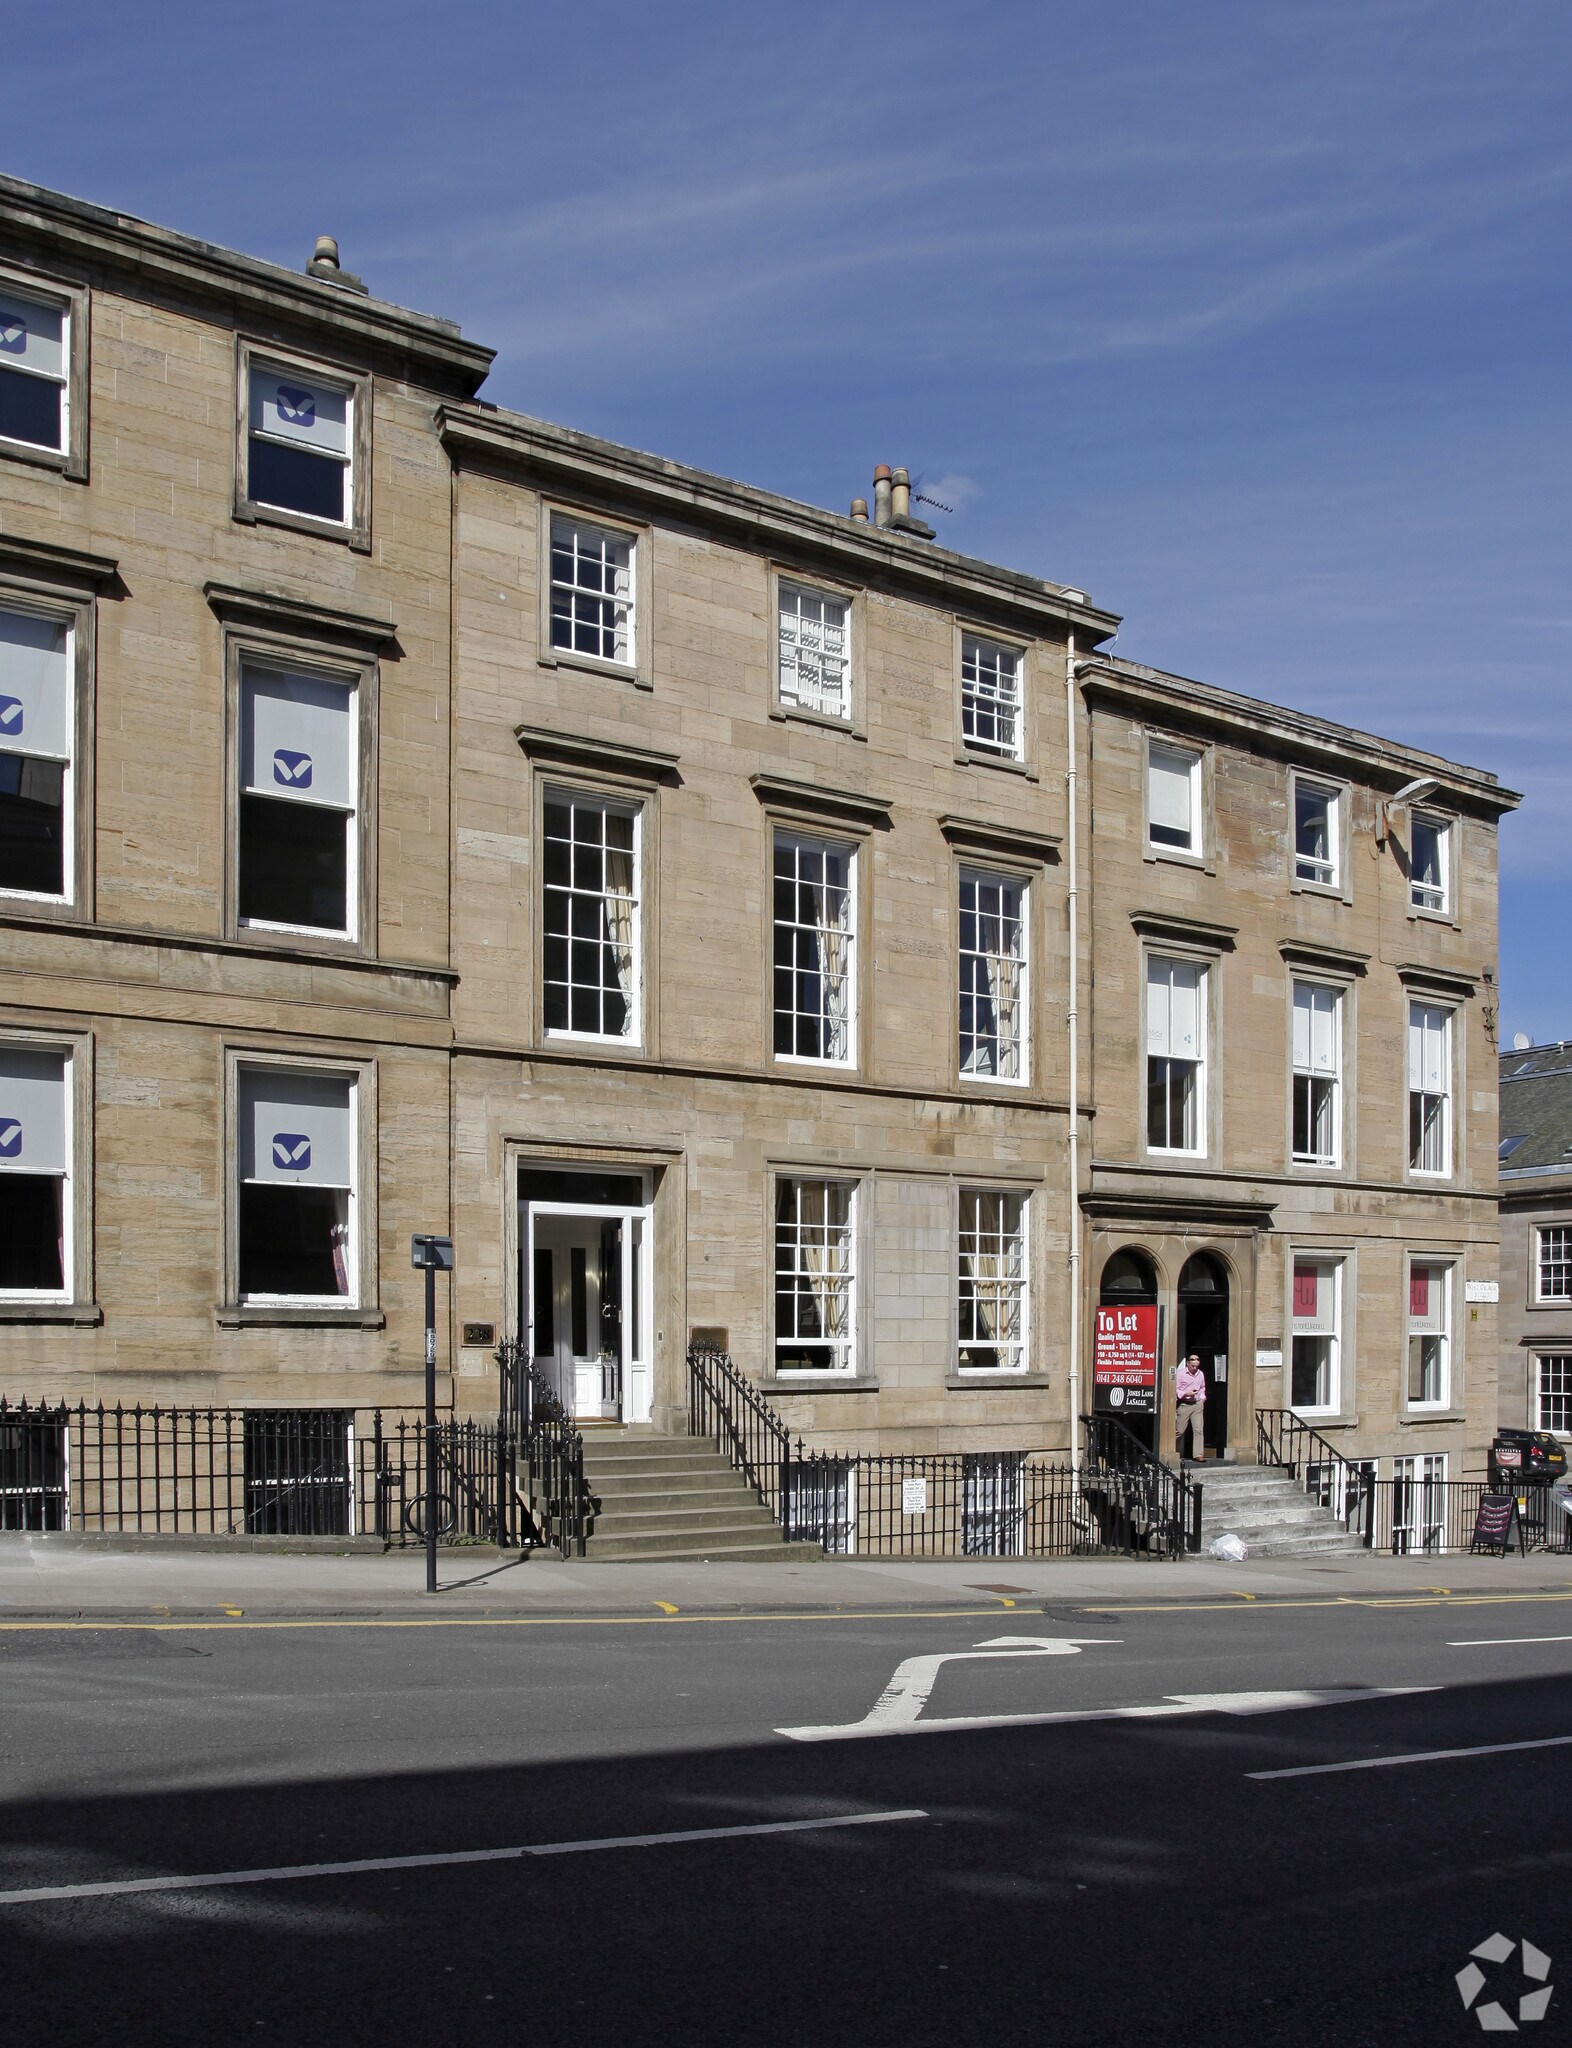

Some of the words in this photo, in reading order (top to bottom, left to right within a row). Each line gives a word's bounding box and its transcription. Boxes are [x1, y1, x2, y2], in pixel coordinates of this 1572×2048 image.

[1098, 1311, 1114, 1331] To
[1117, 1311, 1138, 1331] Let
[1098, 1333, 1115, 1341] Quality
[1097, 1342, 1115, 1350] Ground
[1119, 1342, 1130, 1350] Third
[1131, 1342, 1143, 1350] Floor
[1096, 1374, 1110, 1383] 0141
[1111, 1374, 1125, 1384] 248
[1125, 1374, 1143, 1384] 6040
[1127, 1389, 1141, 1397] JONES
[1141, 1389, 1154, 1398] LANG
